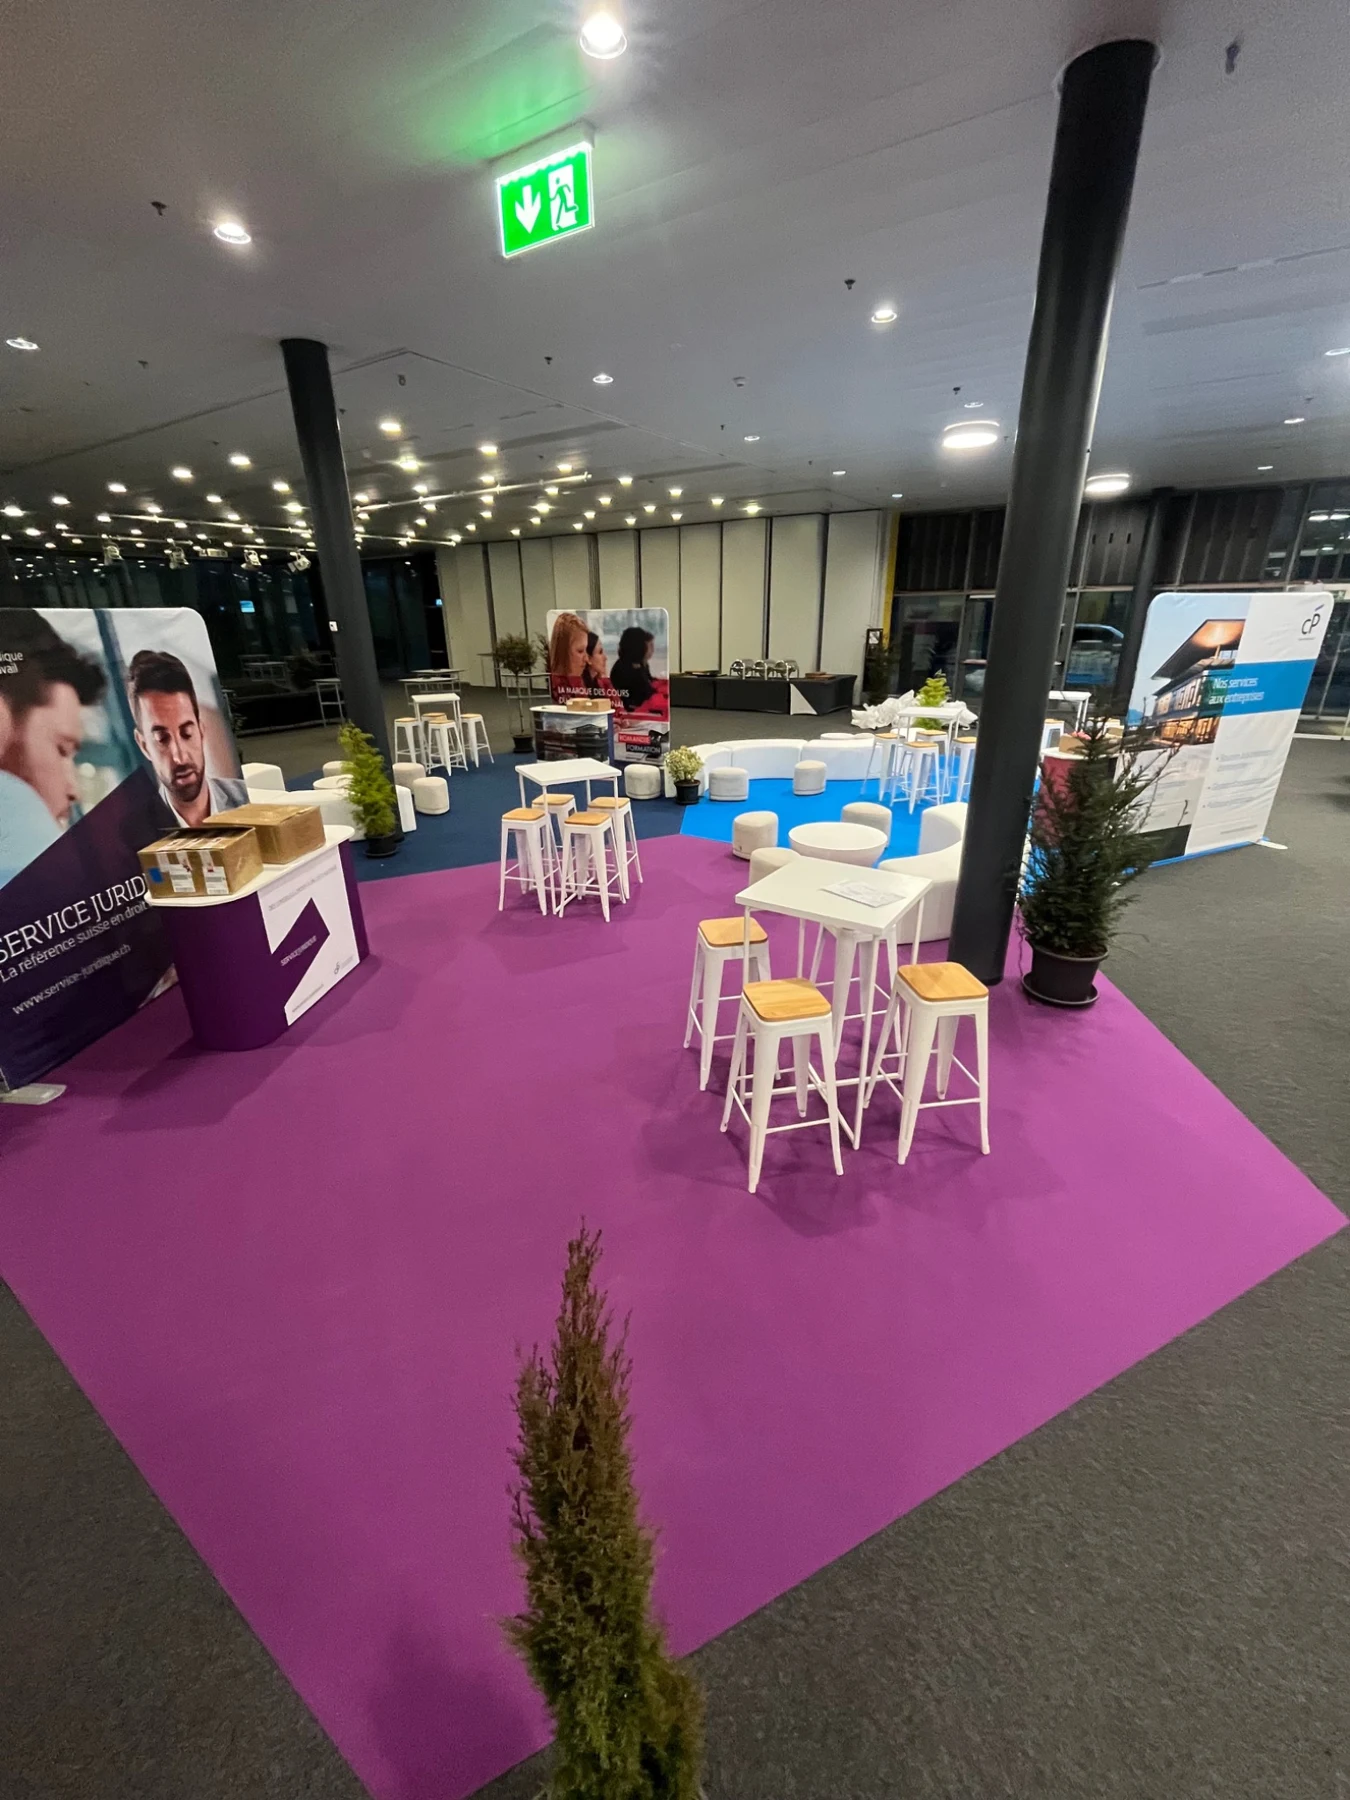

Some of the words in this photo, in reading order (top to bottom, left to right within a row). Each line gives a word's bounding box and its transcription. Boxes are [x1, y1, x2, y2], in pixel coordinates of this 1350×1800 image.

[1213, 677, 1228, 689] Nos
[1228, 677, 1259, 688] services
[557, 685, 565, 694] LA
[566, 686, 592, 696] MARQUE
[593, 687, 605, 696] DES
[606, 688, 630, 697] COURS
[1208, 695, 1224, 705] aux
[1224, 691, 1265, 704] entreprises
[626, 744, 661, 754] FORMATION
[90, 873, 147, 922] JURID
[0, 967, 18, 982] La
[76, 920, 110, 943] suisse
[110, 913, 124, 926] en
[124, 900, 148, 919] droit
[12, 943, 131, 1014] www.service-juridique.ch
